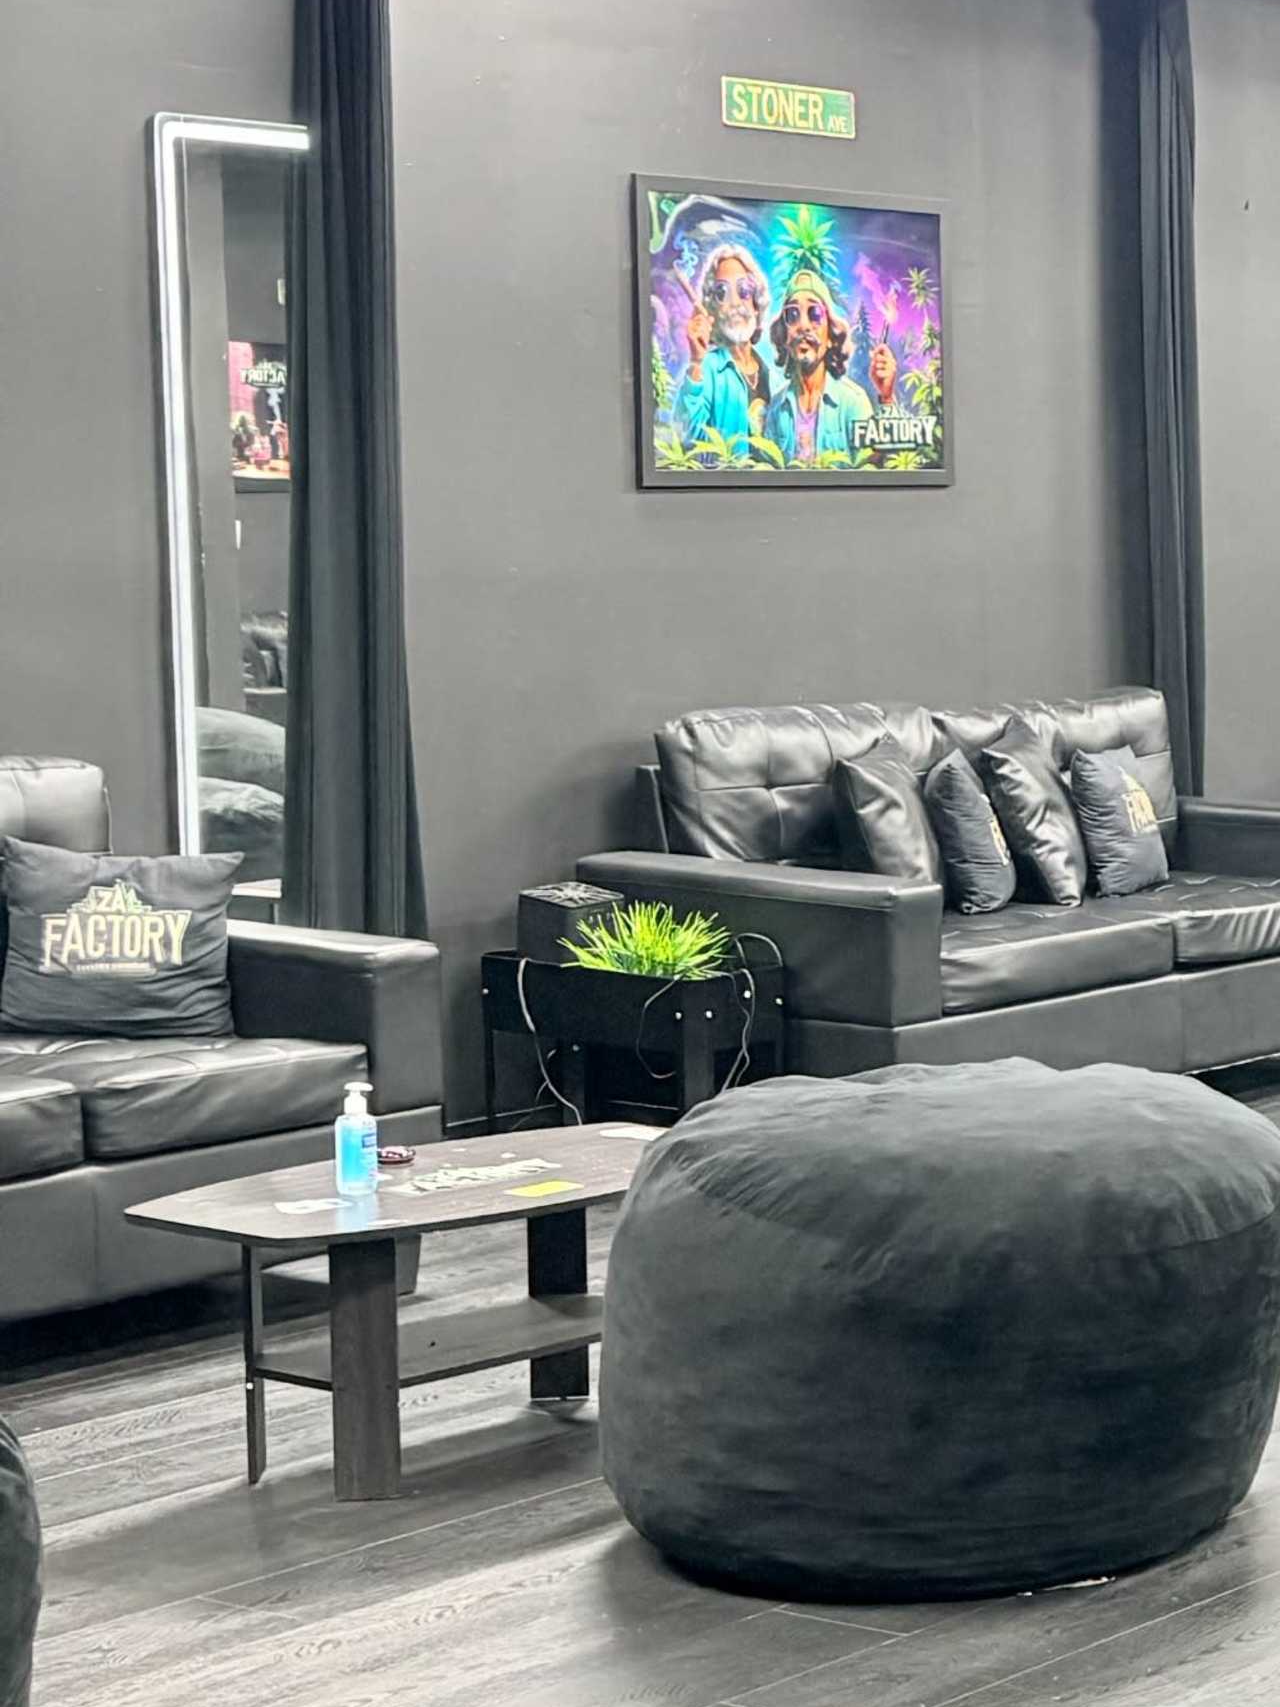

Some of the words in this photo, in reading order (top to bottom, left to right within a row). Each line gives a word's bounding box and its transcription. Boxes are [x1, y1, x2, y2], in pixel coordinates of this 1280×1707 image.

[732, 83, 824, 130] STONER
[827, 115, 848, 133] AVE
[853, 415, 938, 448] FACTORY
[98, 883, 126, 913] ZA
[43, 912, 190, 969] FACTORY
